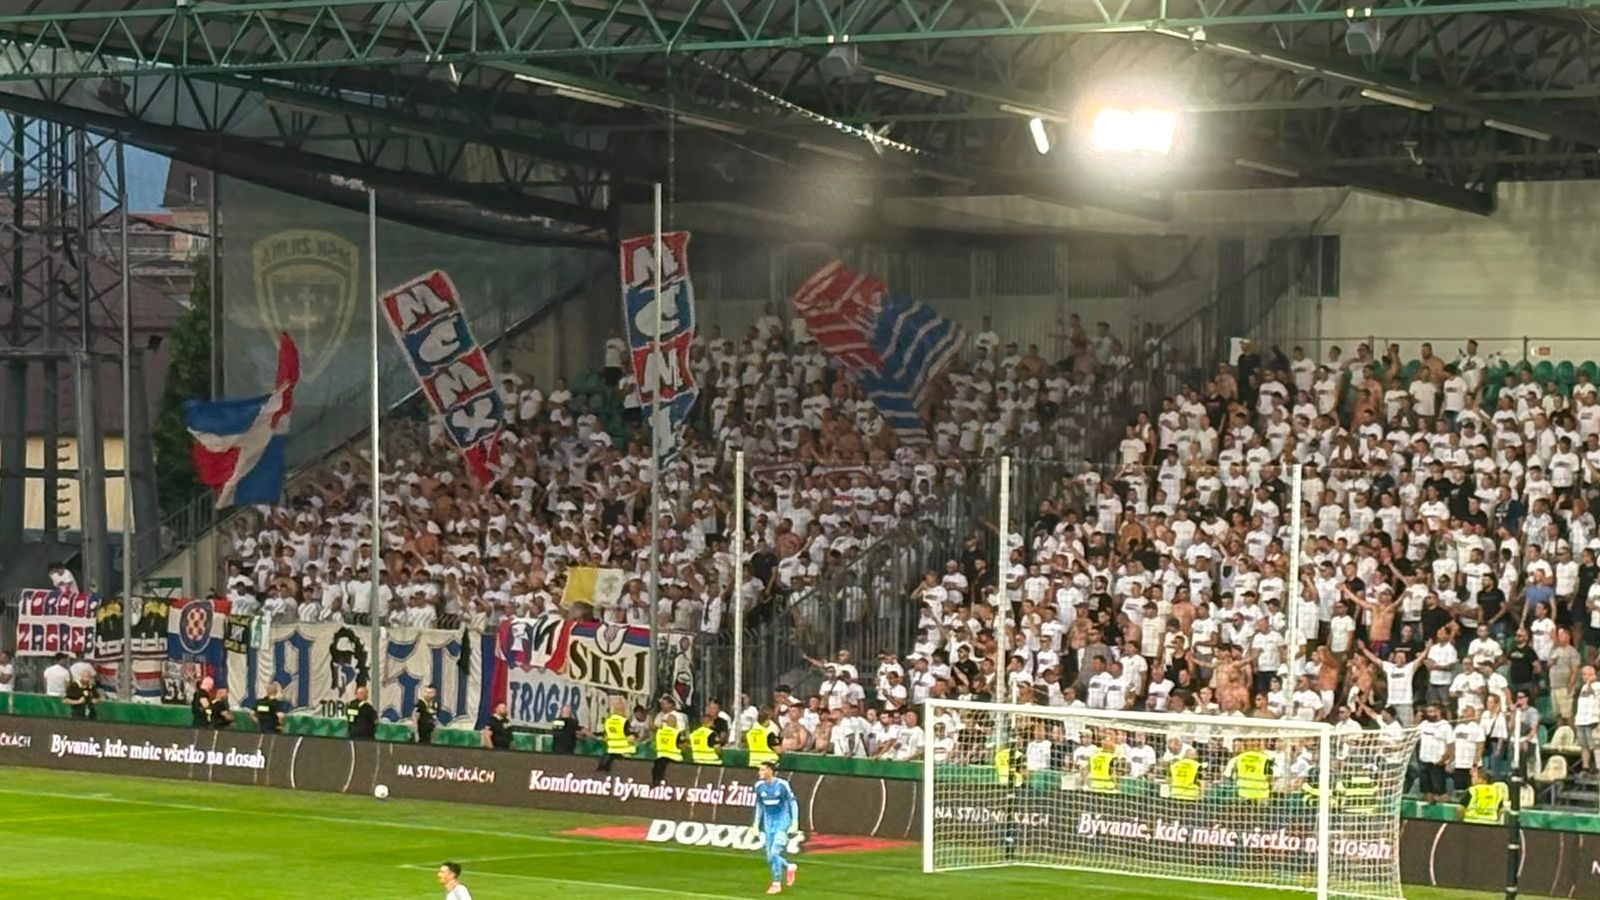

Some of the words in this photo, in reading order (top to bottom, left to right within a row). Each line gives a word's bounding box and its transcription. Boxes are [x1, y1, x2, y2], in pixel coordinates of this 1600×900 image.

[18, 623, 95, 653] ZAGREB
[569, 639, 648, 691] SINJ
[319, 700, 350, 717] TOR
[509, 681, 581, 722] TROGIR
[51, 734, 102, 758] Bývanie,
[105, 739, 127, 758] kde
[130, 743, 162, 761] máte
[164, 744, 204, 764] všetko
[207, 751, 223, 766] na
[225, 747, 265, 768] dosah
[397, 764, 414, 776] NA
[415, 765, 495, 783] STUDNIČKÁCH
[528, 770, 612, 795] Komfortné
[674, 786, 686, 800] v
[686, 783, 726, 805] srdci
[934, 806, 953, 819] NA
[1078, 813, 1151, 840] Bývanie,
[1154, 819, 1188, 843] kde
[1191, 824, 1238, 847] máte
[1241, 827, 1301, 851] všetko
